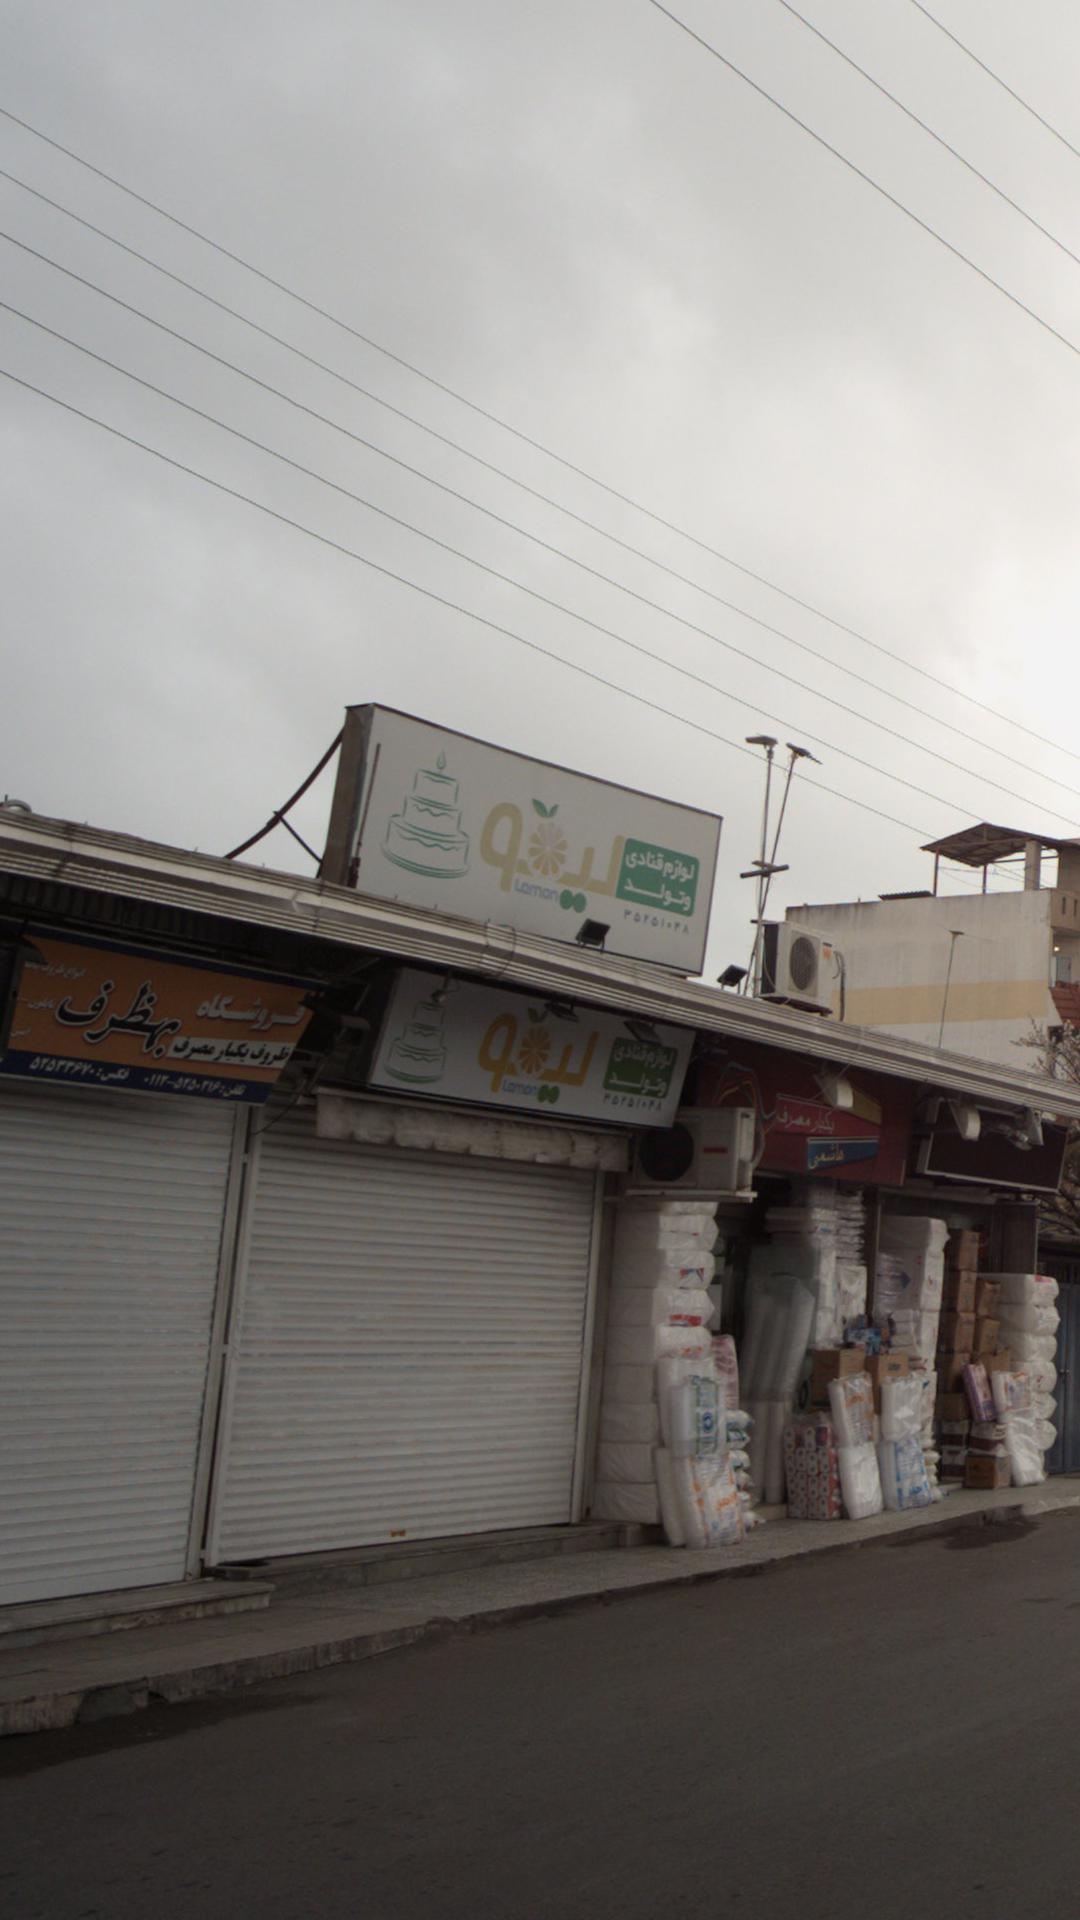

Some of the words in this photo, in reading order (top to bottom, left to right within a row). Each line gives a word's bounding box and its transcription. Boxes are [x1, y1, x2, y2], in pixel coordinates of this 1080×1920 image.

[624, 851, 665, 871] قنادی
[662, 859, 695, 883] لوازم
[196, 992, 307, 1032] فروشگاه
[173, 1037, 216, 1059] مصرف
[214, 1041, 250, 1062] یکبار
[250, 1044, 290, 1066] ظروف
[775, 1104, 811, 1129] مصرف
